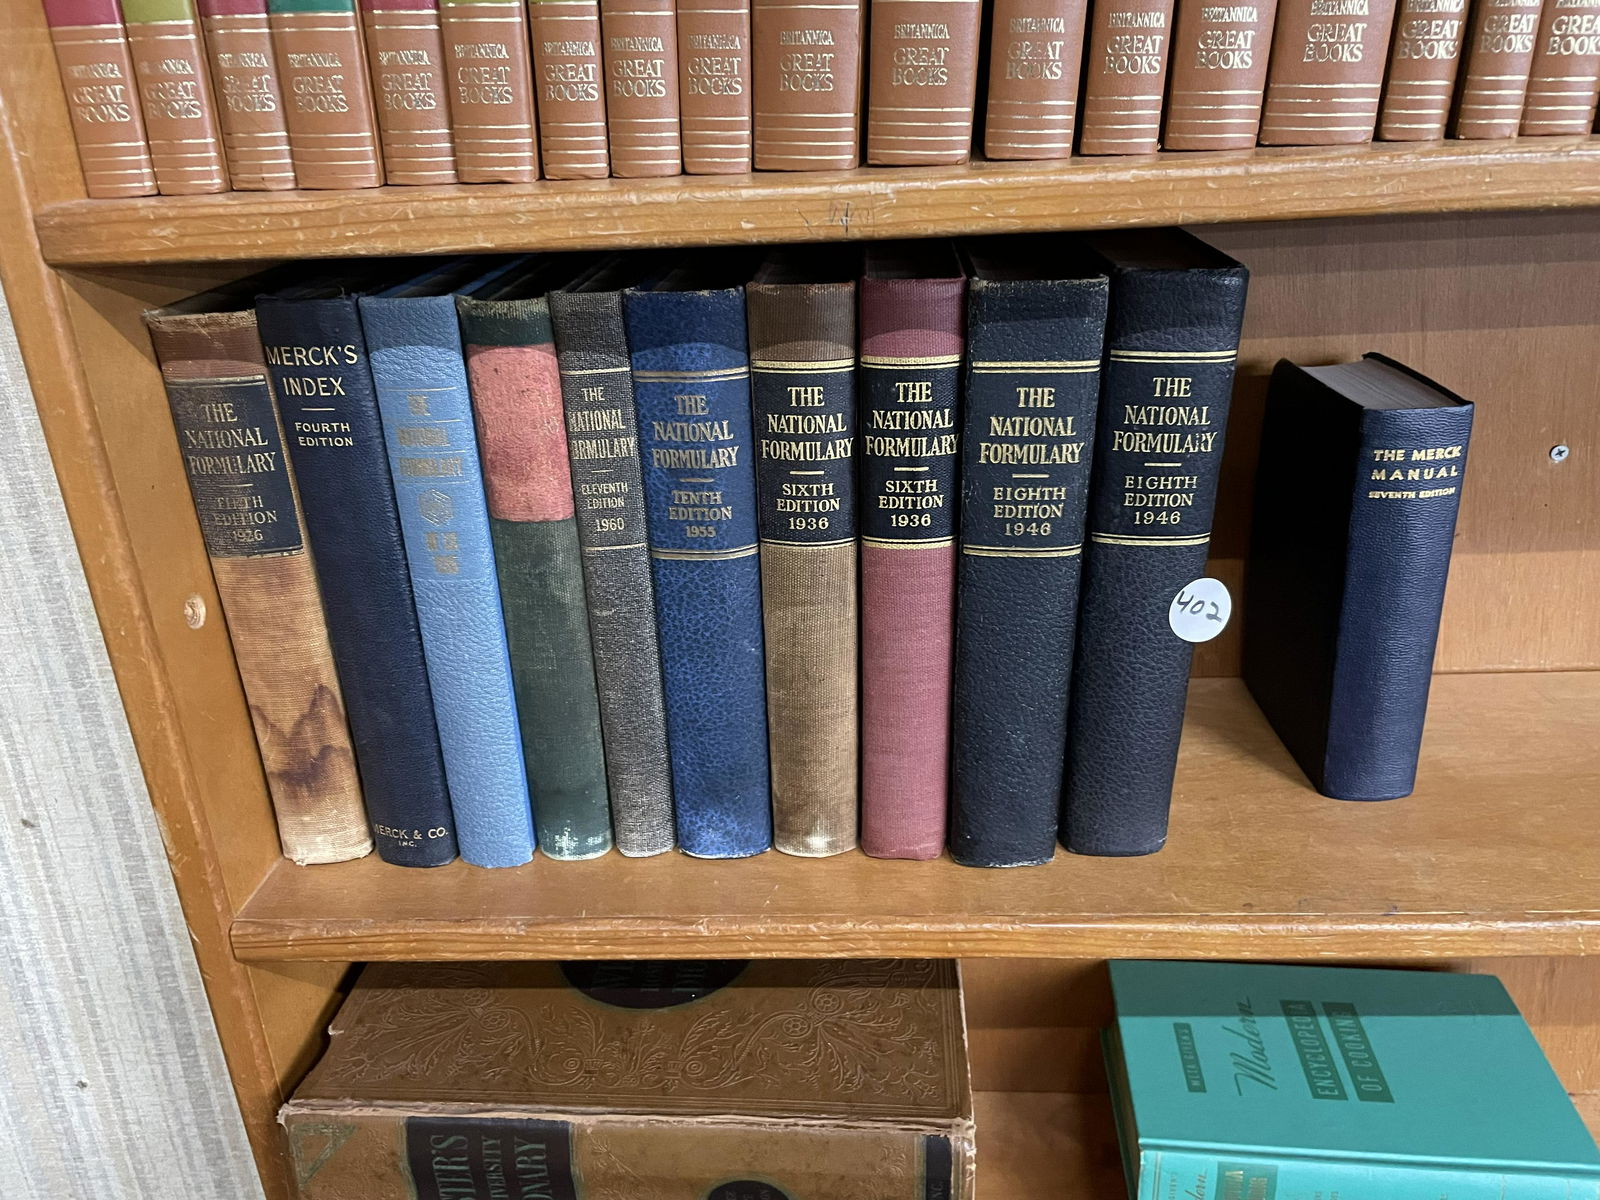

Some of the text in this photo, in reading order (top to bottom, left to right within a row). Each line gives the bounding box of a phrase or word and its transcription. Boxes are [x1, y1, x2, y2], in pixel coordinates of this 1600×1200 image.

[1201, 6, 1258, 23] BRITANNICA
[1483, 14, 1538, 33] GREAT
[1551, 14, 1600, 34] GREA
[780, 30, 835, 46] BRITANNICA
[894, 23, 950, 39] BRITANNICA
[1307, 22, 1368, 43] GREAT
[1402, 19, 1463, 40] GREAT
[1107, 35, 1164, 55] GREAT
[1198, 30, 1255, 49] GREAT
[1480, 34, 1533, 54] BOOKS
[1545, 35, 1600, 55] BOOK
[893, 47, 950, 66] GREAT
[1007, 41, 1064, 60] GREAT
[1302, 43, 1364, 63] BOOKS
[1397, 40, 1459, 60] BOOKS
[612, 59, 665, 78] GREAT
[688, 57, 742, 76] GREAT
[780, 53, 835, 72] GREAT
[1103, 55, 1161, 75] BOOKS
[1194, 50, 1253, 70] BOOKS
[458, 66, 511, 85] GREAT
[544, 63, 597, 82] GREAT
[892, 67, 948, 86] BOOKS
[1006, 61, 1063, 80] BOOKS
[293, 75, 344, 94] GREAT
[382, 72, 433, 91] GREAT
[613, 79, 667, 97] BOOKS
[688, 77, 743, 95] BOOKS
[779, 73, 834, 92] BOOKS
[384, 92, 437, 110] BOOKS
[459, 86, 513, 104] BOOKS
[545, 83, 599, 102] BOOKS
[296, 94, 349, 113] BOOKS
[265, 345, 358, 367] MERCK'S
[283, 376, 346, 397] INDEX
[581, 387, 606, 401] THE
[895, 382, 933, 403] THE
[1153, 377, 1192, 398] THE
[674, 395, 709, 416] THE
[787, 386, 825, 407] THE
[1016, 387, 1055, 408] THE
[200, 402, 238, 423] THE
[569, 409, 626, 432] NATIONAL
[872, 409, 954, 430] NATIONAL
[1124, 405, 1210, 426] NATIONAL
[295, 421, 351, 434] FOURTH
[652, 420, 734, 442] NATIONAL
[767, 413, 847, 434] NATIONAL
[989, 416, 1077, 437] NATIONAL
[184, 427, 269, 449] NATIONAL
[298, 436, 354, 448] EDITION
[865, 433, 960, 457] FORMULARY
[1112, 431, 1218, 454] FORMULARY
[572, 437, 635, 459] ORMULARY
[651, 446, 740, 469] FORMULARY
[761, 437, 854, 461] FORMULARY
[978, 442, 1085, 465] FORMULARY
[1374, 445, 1462, 462] THE MERCK
[188, 451, 276, 475] FORMULARY
[1124, 475, 1198, 489] EIGHTH
[1371, 465, 1458, 481] MANUAL
[581, 482, 629, 495] ELEVENTH
[782, 483, 834, 497] SIXTH
[885, 480, 938, 493] SIXTH
[993, 486, 1067, 501] EIGHTH
[1368, 487, 1456, 499] SEVENTH EDITION
[587, 497, 625, 509] EDITION
[672, 490, 722, 505] TENTH
[776, 497, 841, 512] EDITION
[878, 495, 944, 510] EDITION
[1124, 493, 1194, 507] EDITION
[212, 509, 278, 526] EDITION
[669, 506, 733, 520] EDITION
[993, 502, 1064, 519] EDITION
[1134, 511, 1181, 525] 1946
[596, 517, 625, 532] 1960
[788, 517, 829, 530] 1936
[890, 514, 932, 527] 1936
[1004, 522, 1051, 536] 1946
[685, 525, 716, 538] 1955
[1176, 590, 1222, 623] 402
[374, 823, 449, 840] MERCK & CO.
[398, 840, 417, 848] INC.
[1222, 996, 1278, 1096] Modern
[1288, 1003, 1339, 1096] ENCYCLOPEDA
[1330, 1008, 1383, 1092] OF COOKIN
[430, 1134, 477, 1200] TER'S
